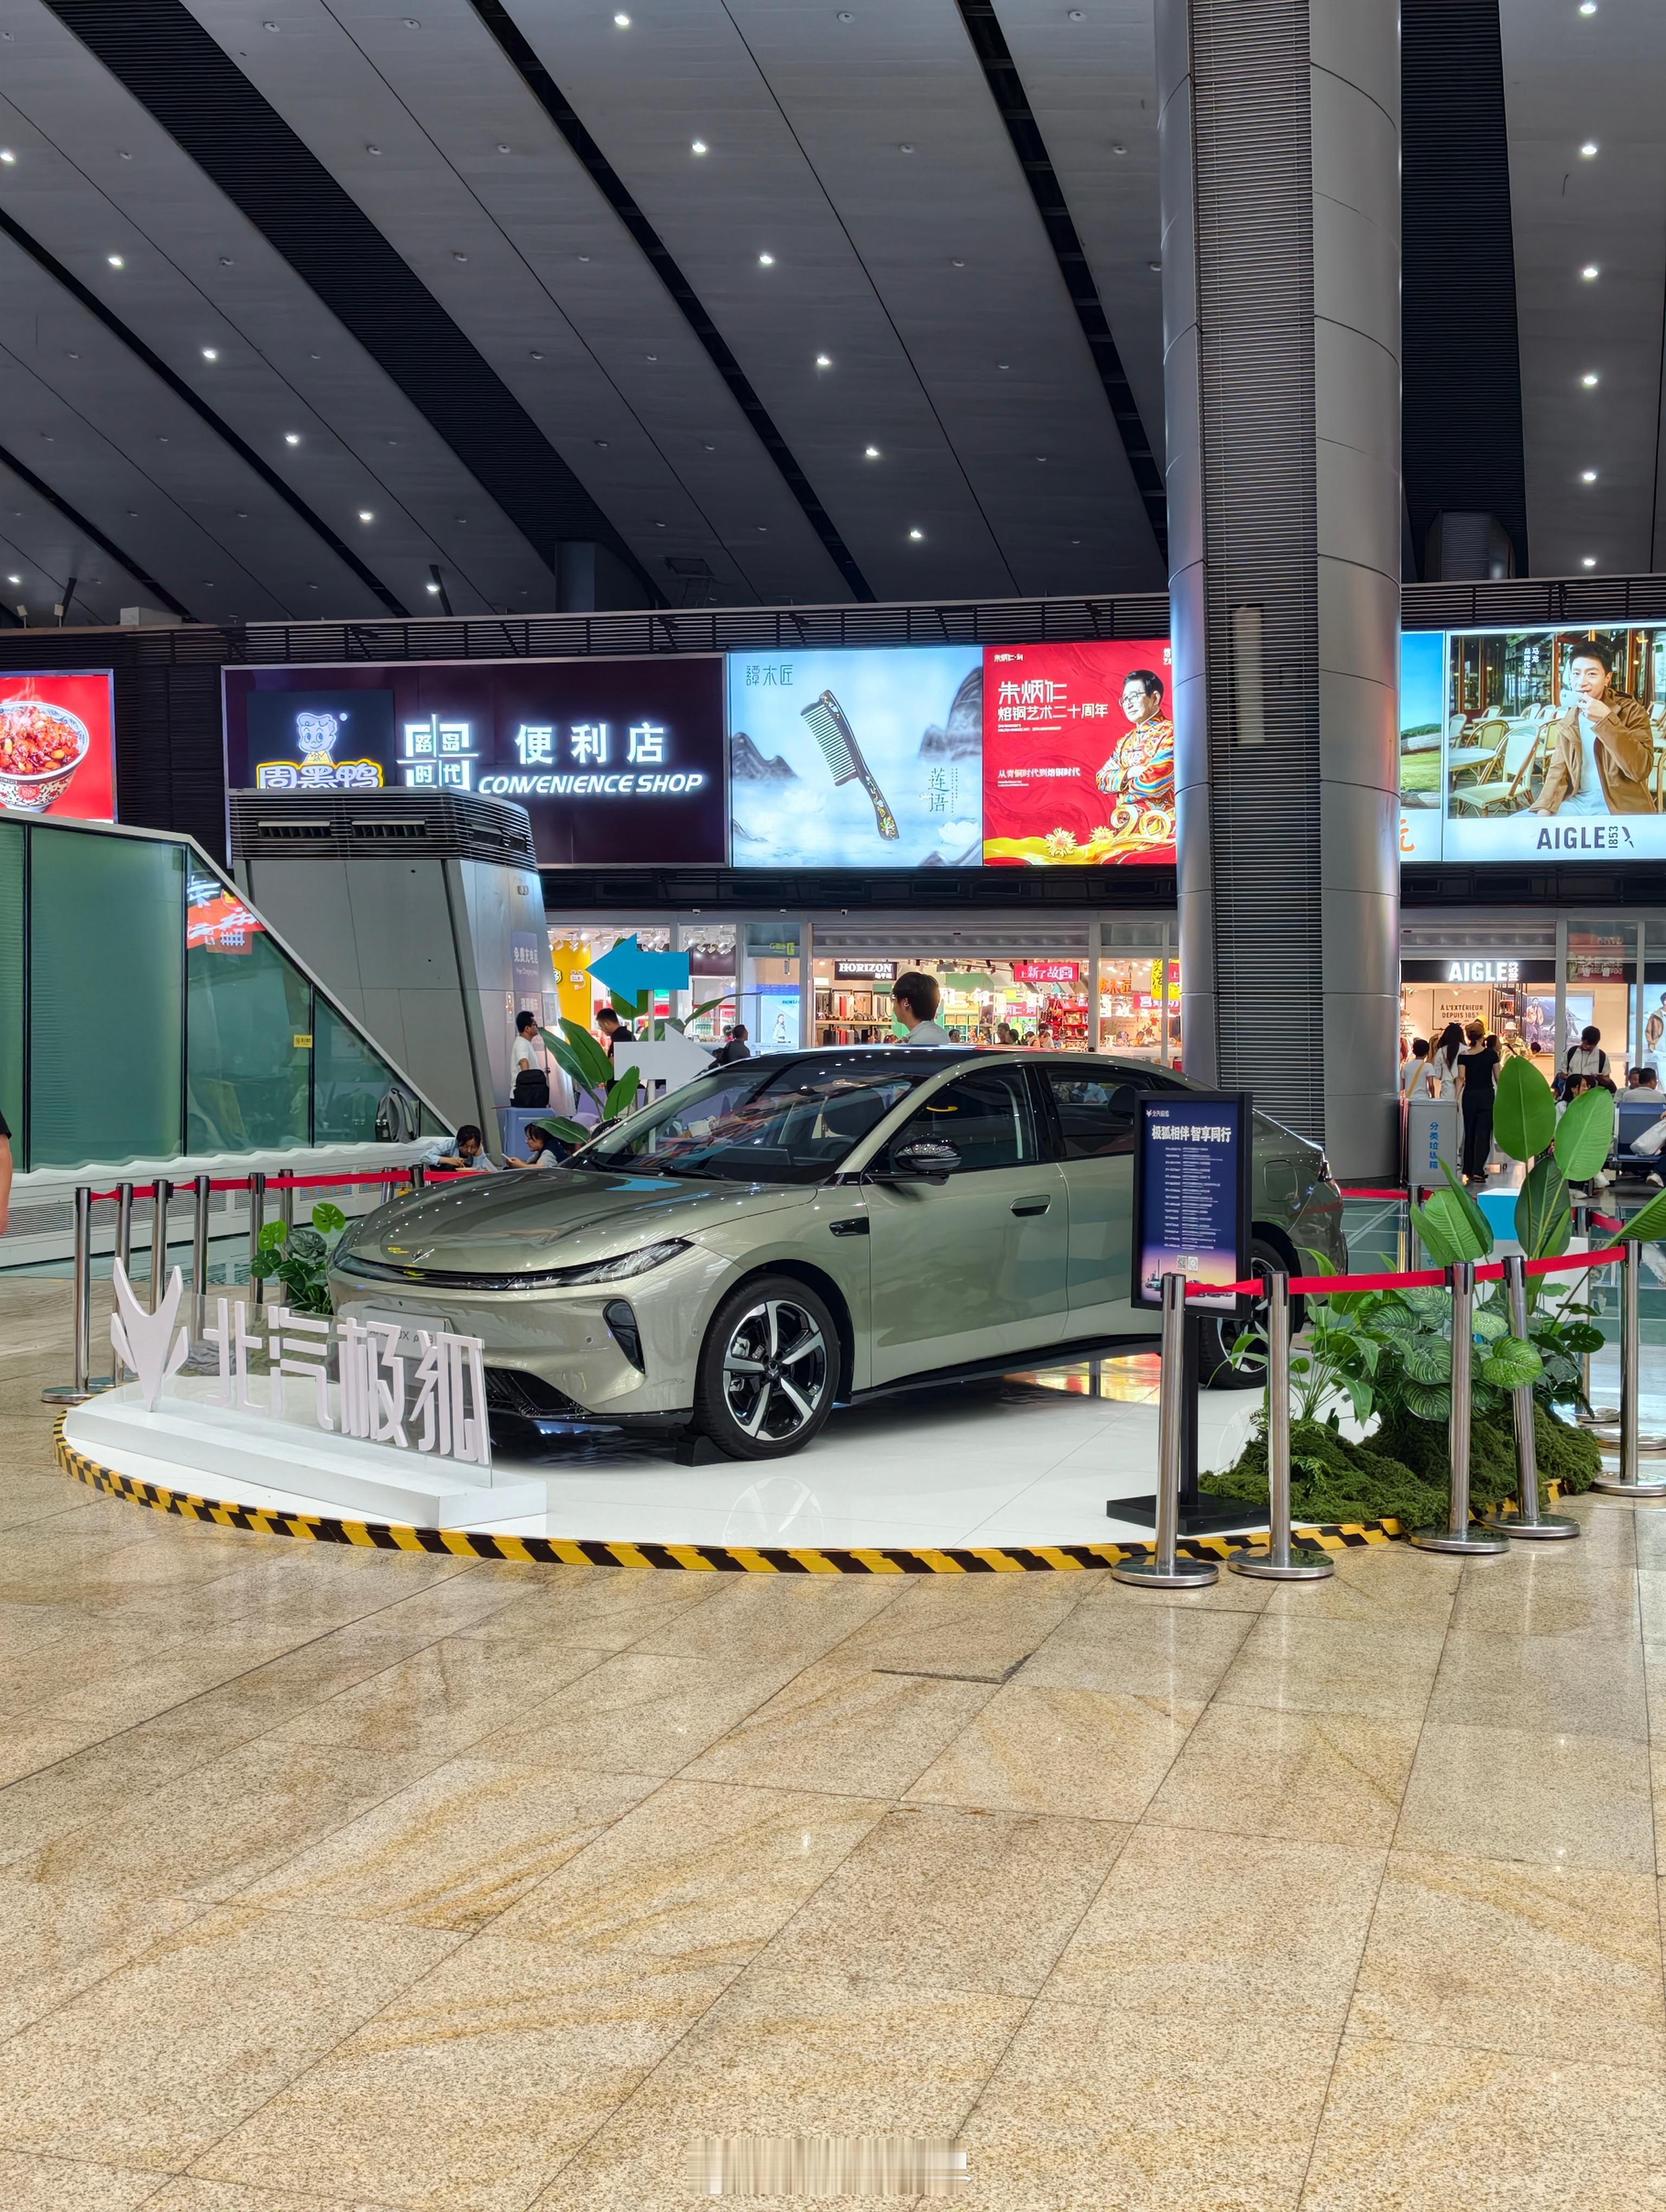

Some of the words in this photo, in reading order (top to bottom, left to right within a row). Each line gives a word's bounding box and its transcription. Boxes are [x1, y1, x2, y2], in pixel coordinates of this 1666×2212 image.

[1532, 647, 1540, 663] 马龙
[998, 679, 1067, 705] 朱炳仁
[997, 703, 1108, 722] 熔铜艺术二十周年
[515, 722, 664, 765] 便利店
[259, 763, 380, 789] 周黑鸭
[479, 774, 636, 794] CONVENIENCE
[636, 774, 703, 793] SHOP
[928, 767, 950, 812] 莲语
[1536, 827, 1605, 850] AIGLE
[1608, 826, 1618, 848] 1853
[838, 963, 893, 973] HORIZON
[1449, 962, 1508, 981] AIGLE
[1152, 1125, 1190, 1141] 极狐相伴
[1190, 1126, 1232, 1143] 智享同行
